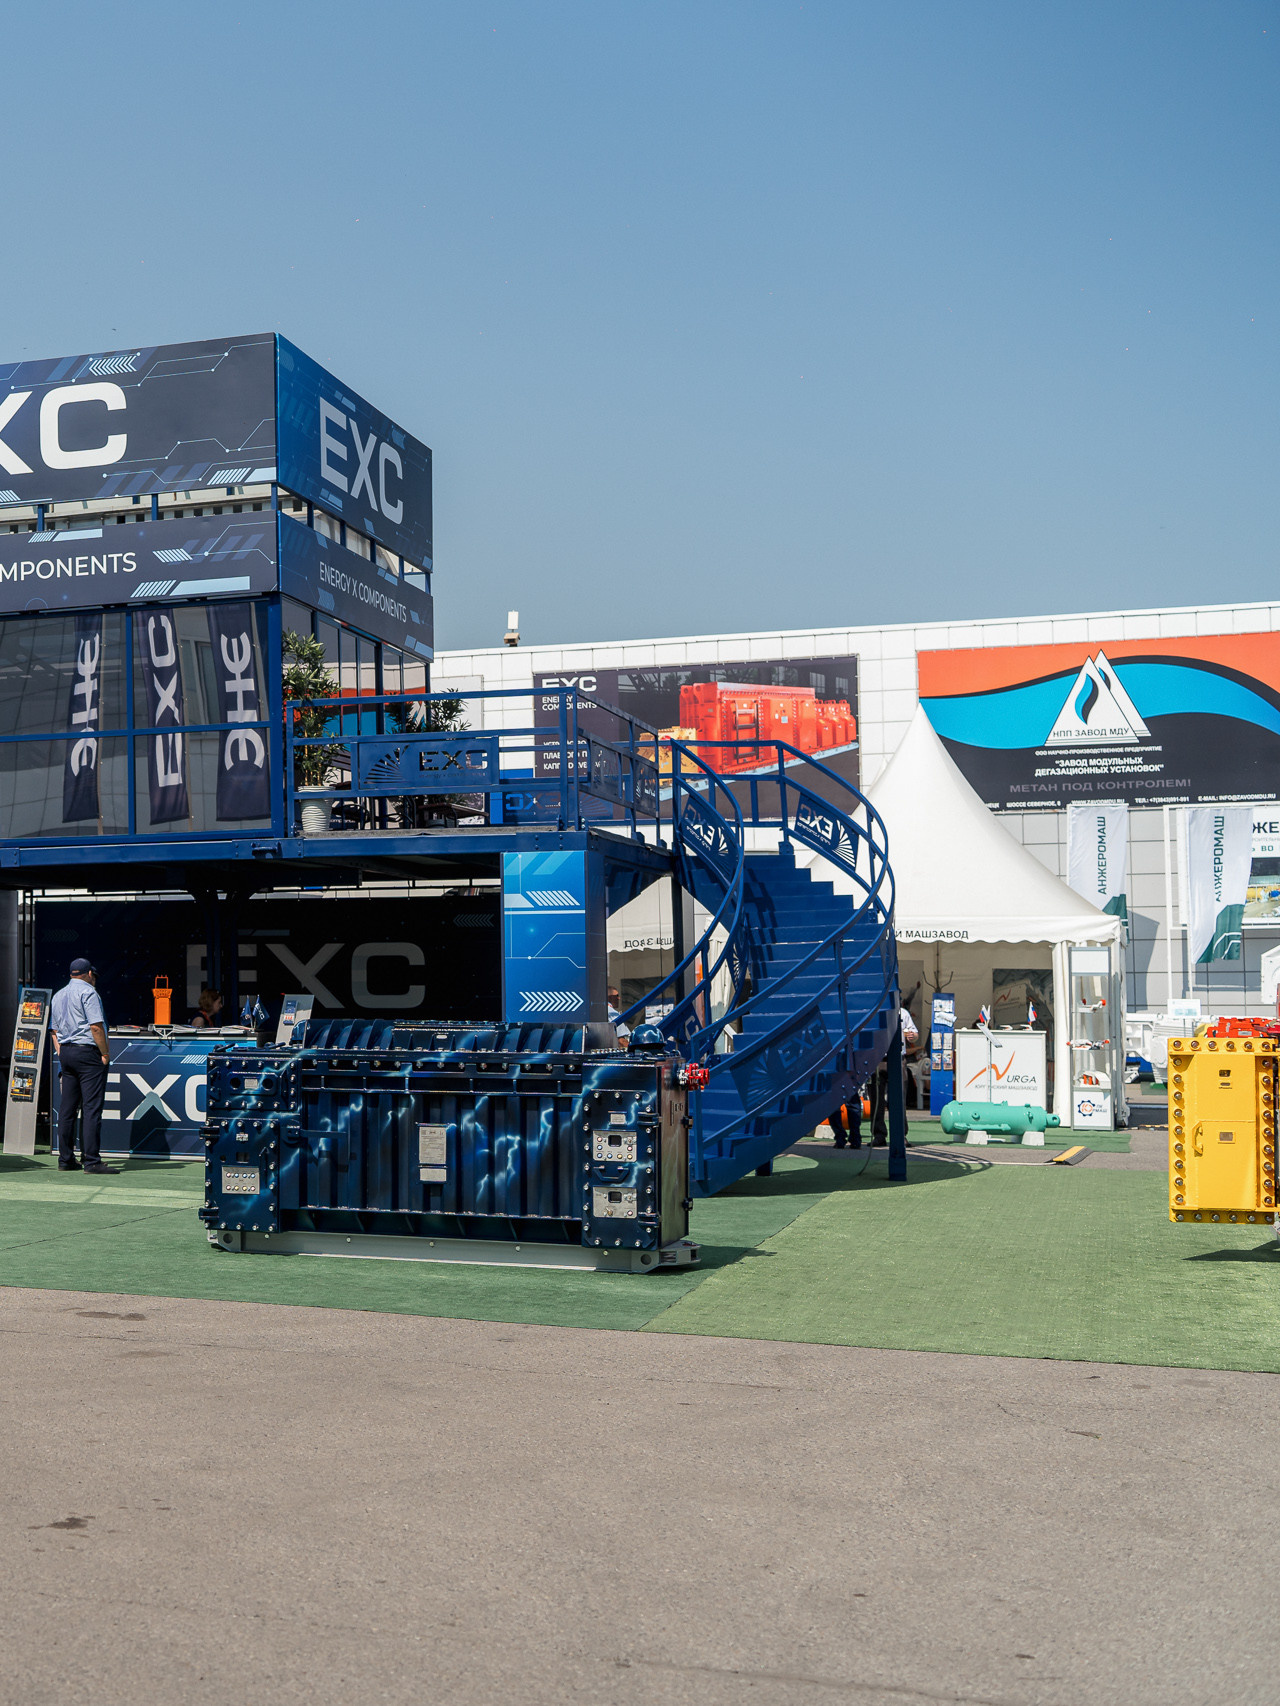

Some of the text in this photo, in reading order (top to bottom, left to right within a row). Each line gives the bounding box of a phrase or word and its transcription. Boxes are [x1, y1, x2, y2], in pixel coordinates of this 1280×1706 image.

[319, 396, 405, 525] EXC
[320, 561, 407, 623] ENERGY X COMPONENTS
[542, 675, 597, 692] EXC
[542, 696, 573, 704] ENEY
[542, 702, 597, 711] COMOENTS
[1052, 728, 1130, 738] НПП ЗАВОД МДУ
[419, 750, 488, 771] EXC
[1089, 757, 1143, 766] МОДУЛЬНЫХ
[1034, 767, 1109, 777] ДЕГАЗАЦИОННЫХ
[1009, 778, 1192, 793] МЕТАН ПОД КОНТРОЛЕМ!
[1097, 816, 1106, 895] АНЖЕРОМАШ
[906, 930, 969, 940] МАШЗАВОД
[186, 942, 427, 1009] EXC
[1006, 1075, 1037, 1084] URGA
